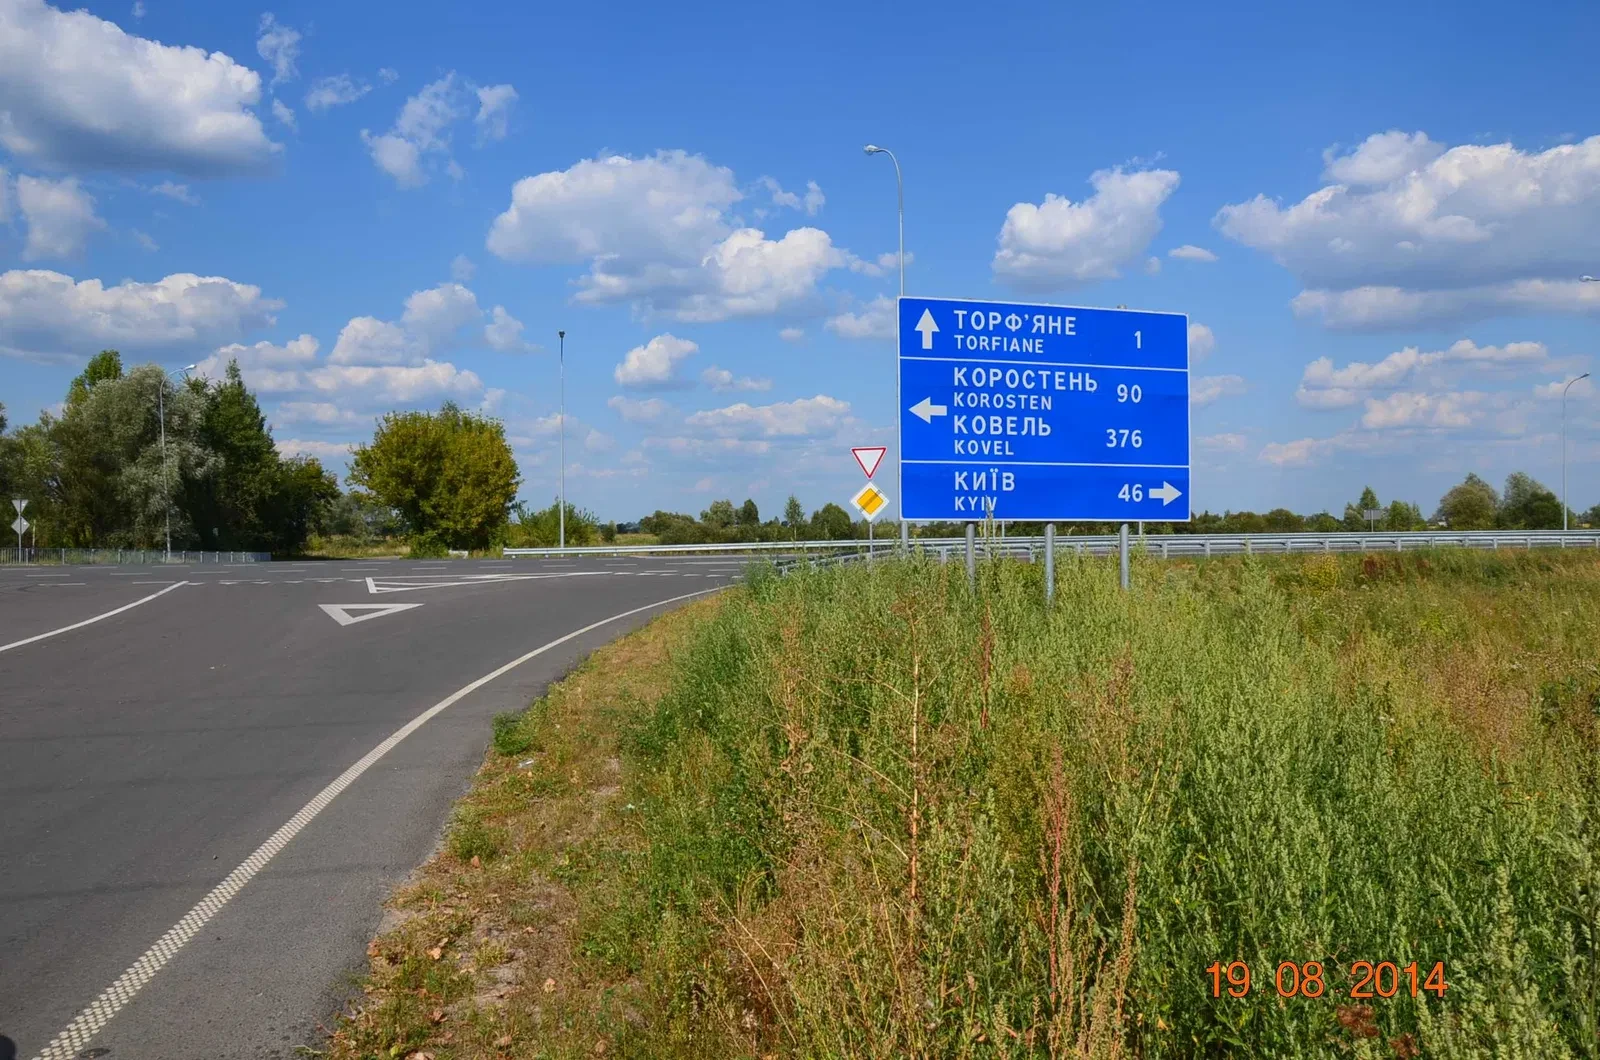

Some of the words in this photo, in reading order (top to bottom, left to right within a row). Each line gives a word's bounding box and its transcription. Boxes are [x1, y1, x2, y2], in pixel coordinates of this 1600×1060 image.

[953, 334, 1044, 354] TORFIANE
[1133, 330, 1143, 349] 1
[953, 366, 1098, 392] КОРОСТЕНЬ
[953, 392, 1052, 411] KOROSTEN
[1116, 383, 1142, 404] 90
[953, 415, 1052, 437] КОВЕЛЬ
[954, 439, 1015, 456] KOVEL
[1105, 428, 1143, 448] 376
[954, 468, 1016, 492] КИЇВ
[1117, 483, 1143, 503] 46
[954, 495, 998, 512] KYIV
